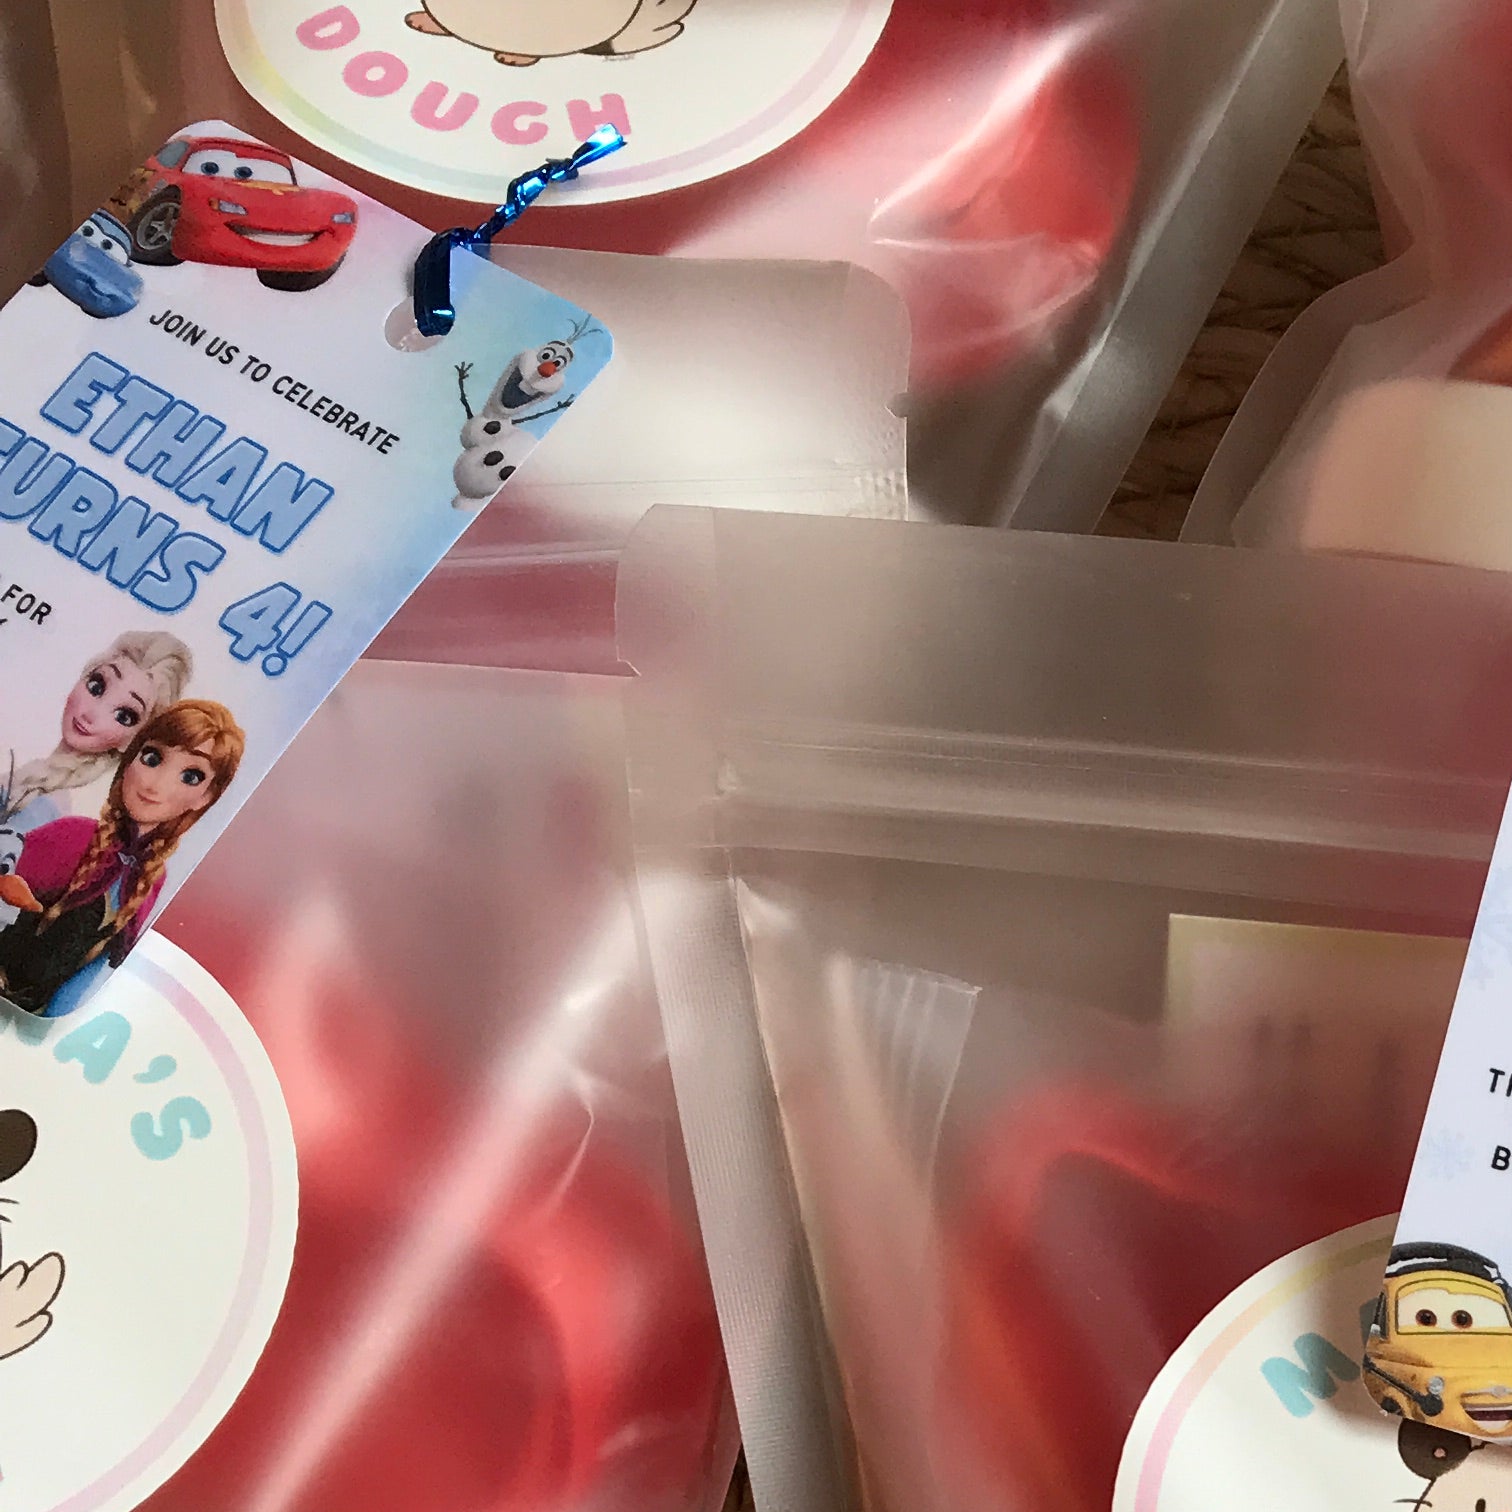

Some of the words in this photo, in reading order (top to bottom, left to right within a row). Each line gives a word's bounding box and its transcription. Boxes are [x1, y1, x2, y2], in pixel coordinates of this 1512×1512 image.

[295, 4, 632, 145] DOUGH
[39, 351, 336, 554] ETHAN
[149, 310, 207, 347] JOIN
[204, 336, 240, 365] US
[239, 355, 272, 382] TO
[272, 375, 400, 455] CELEBRATE
[0, 584, 53, 625] FOR
[218, 581, 334, 677] 4!
